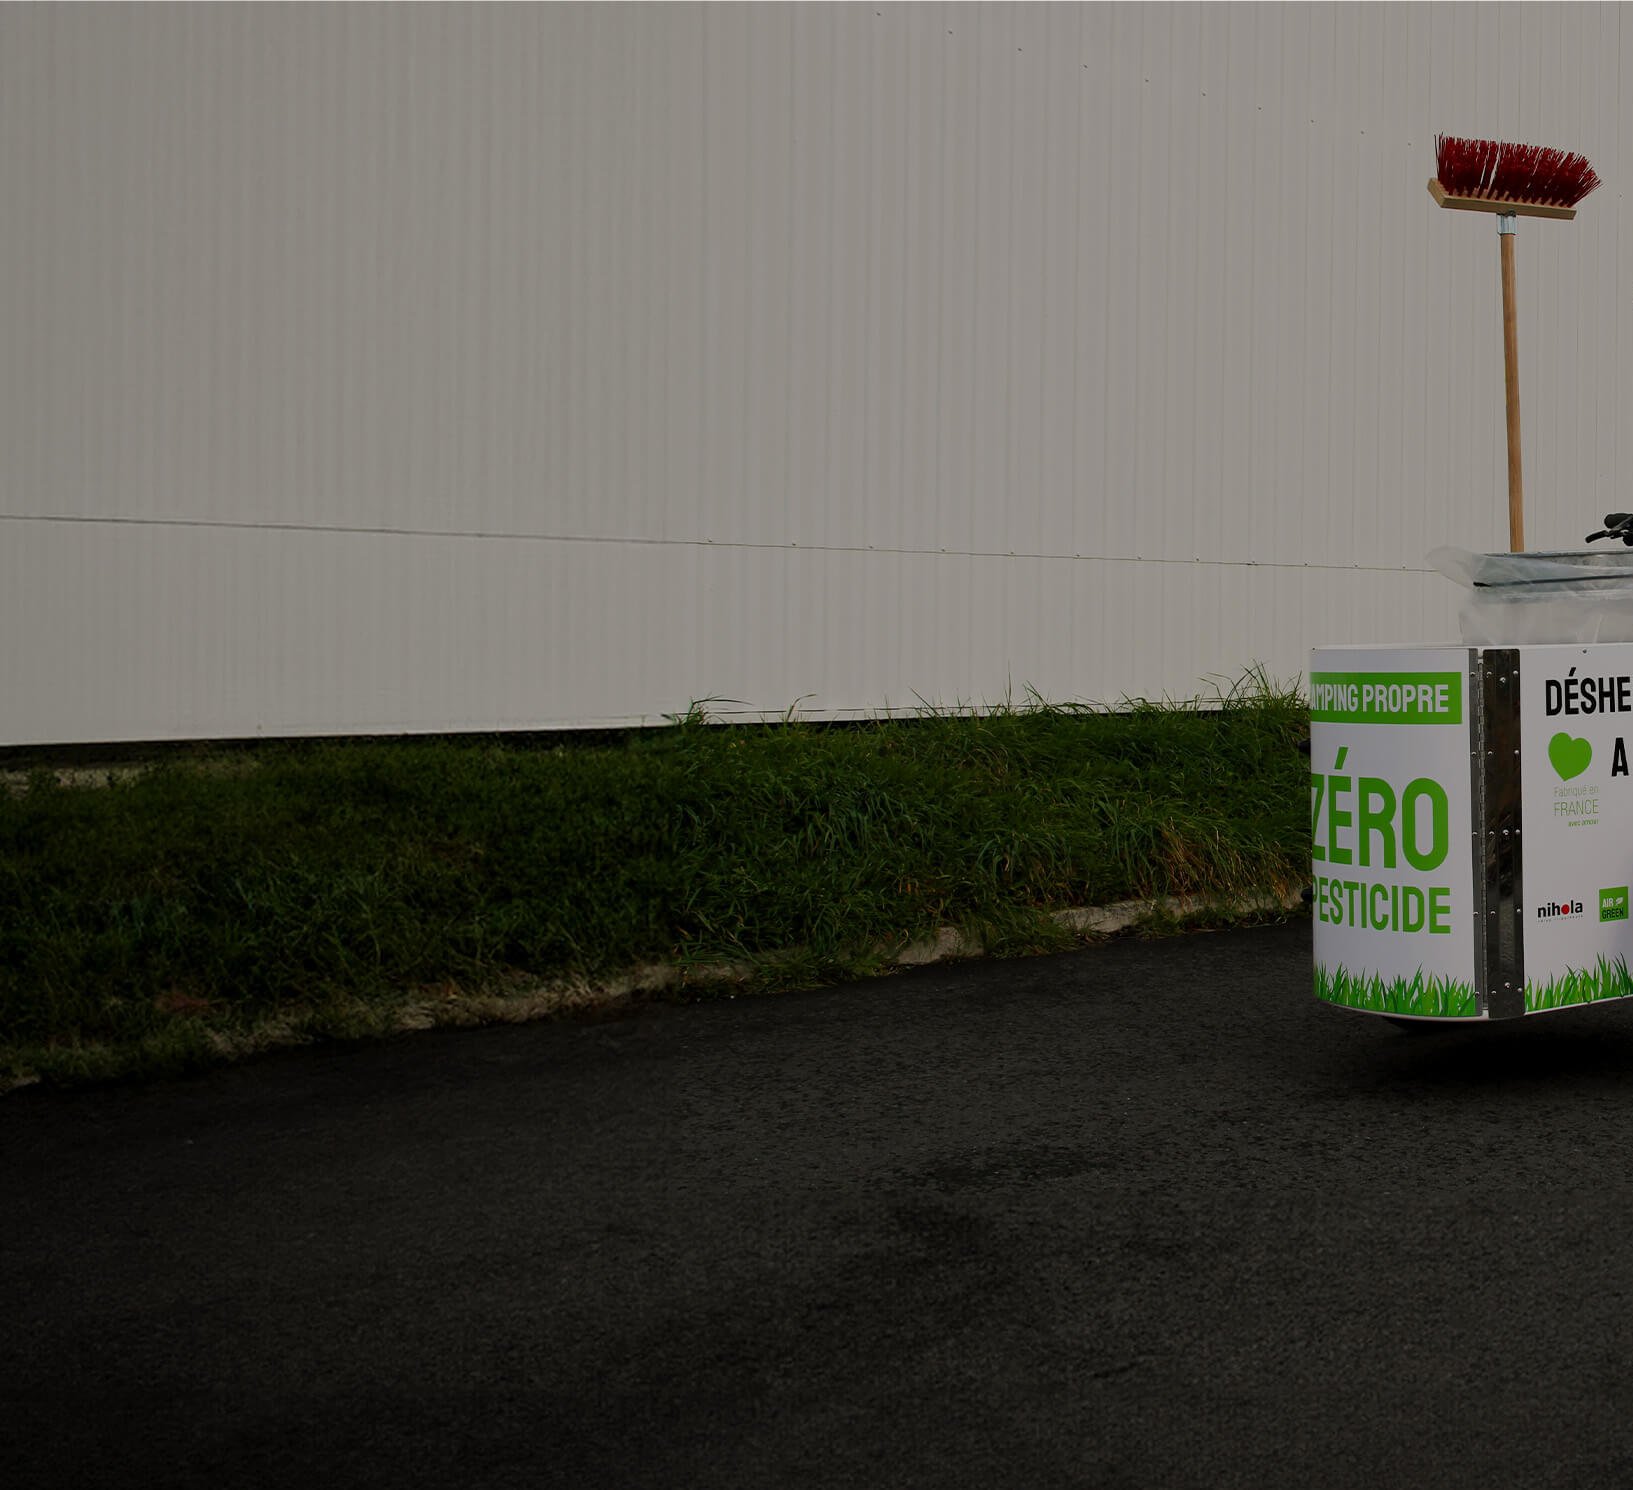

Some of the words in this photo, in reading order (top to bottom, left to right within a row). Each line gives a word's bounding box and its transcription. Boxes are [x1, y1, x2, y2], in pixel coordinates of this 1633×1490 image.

[1362, 684, 1449, 713] PROPRE
[1611, 737, 1629, 777] A
[1311, 746, 1449, 872] ZÉRO
[1553, 799, 1600, 817] FRANCE
[1537, 900, 1583, 918] nihola
[1602, 898, 1614, 908] AIR
[1602, 907, 1624, 919] GREEN
